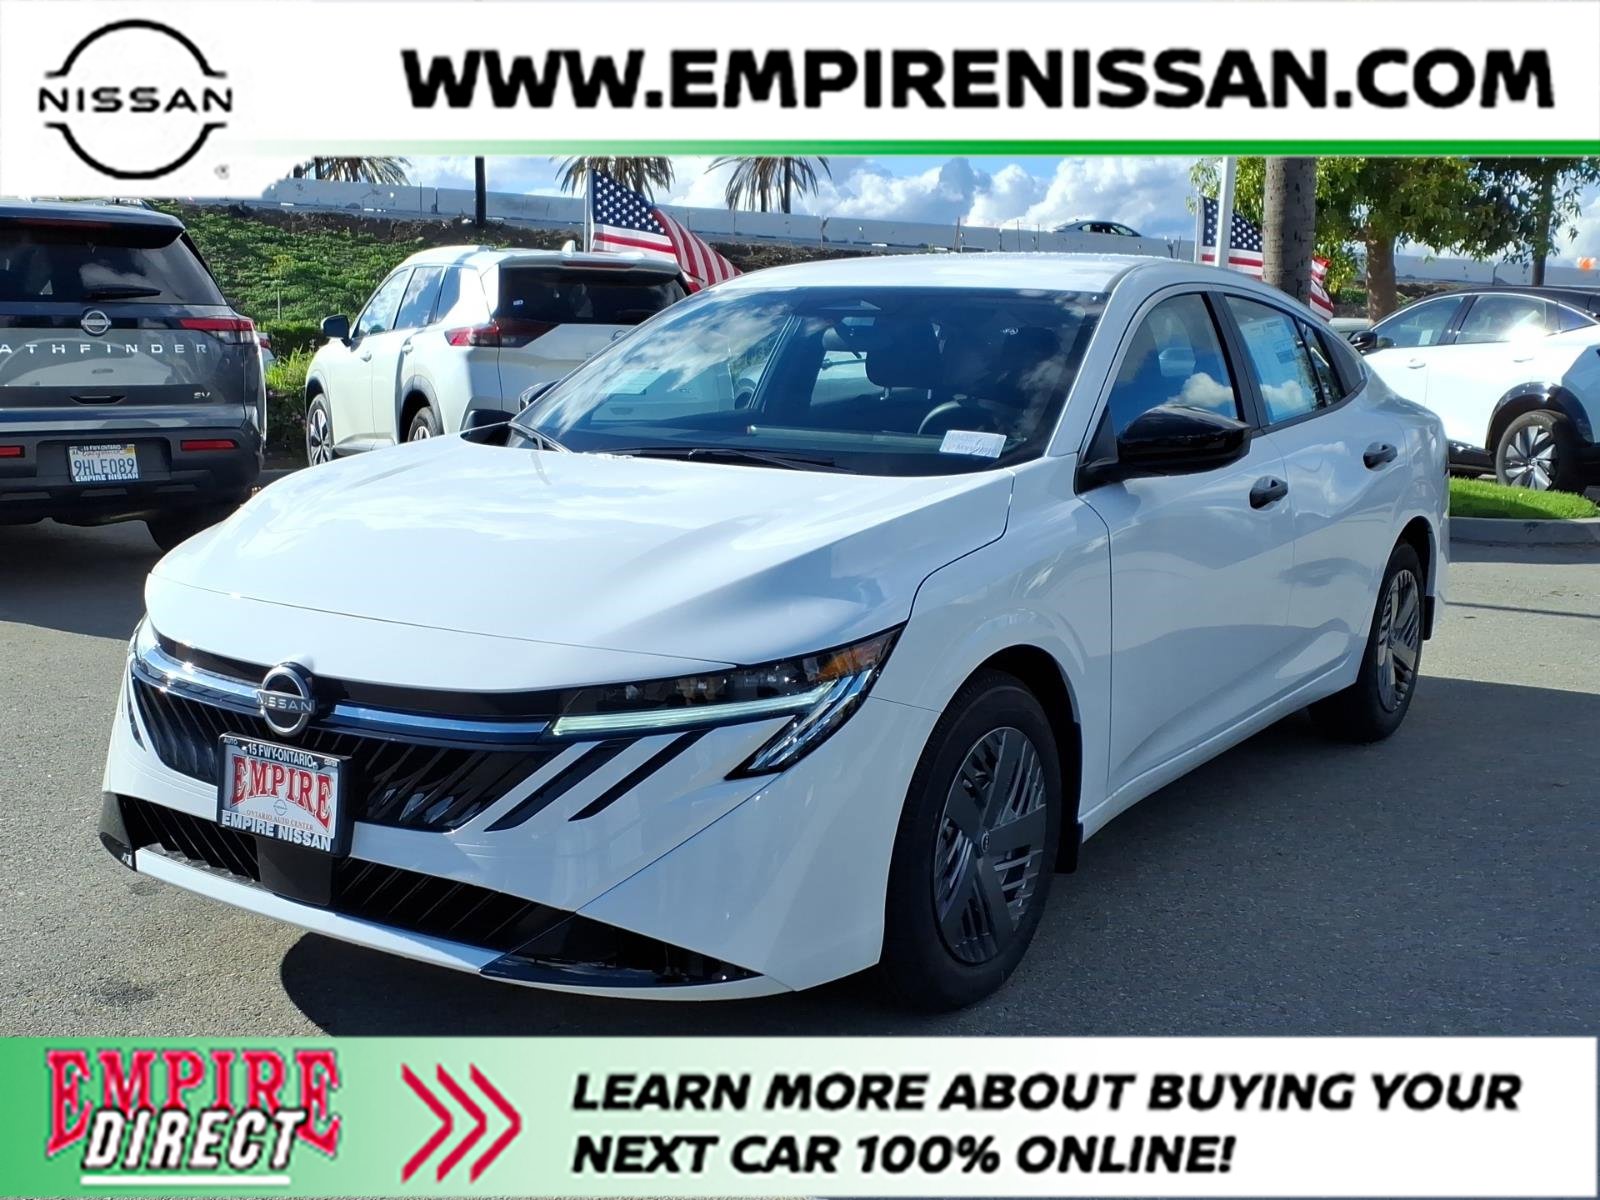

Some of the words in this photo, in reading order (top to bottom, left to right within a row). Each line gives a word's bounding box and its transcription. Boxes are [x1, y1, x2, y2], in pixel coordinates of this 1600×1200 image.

[193, 391, 211, 399] SV
[73, 457, 135, 477] 9HLE089
[248, 743, 258, 755] 15
[258, 745, 314, 768] FWY-ONTARIO
[230, 754, 333, 833] EMPIRE
[246, 808, 273, 821] ONTARIO
[221, 810, 275, 837] EMPIRE
[278, 825, 332, 852] NISSAN
